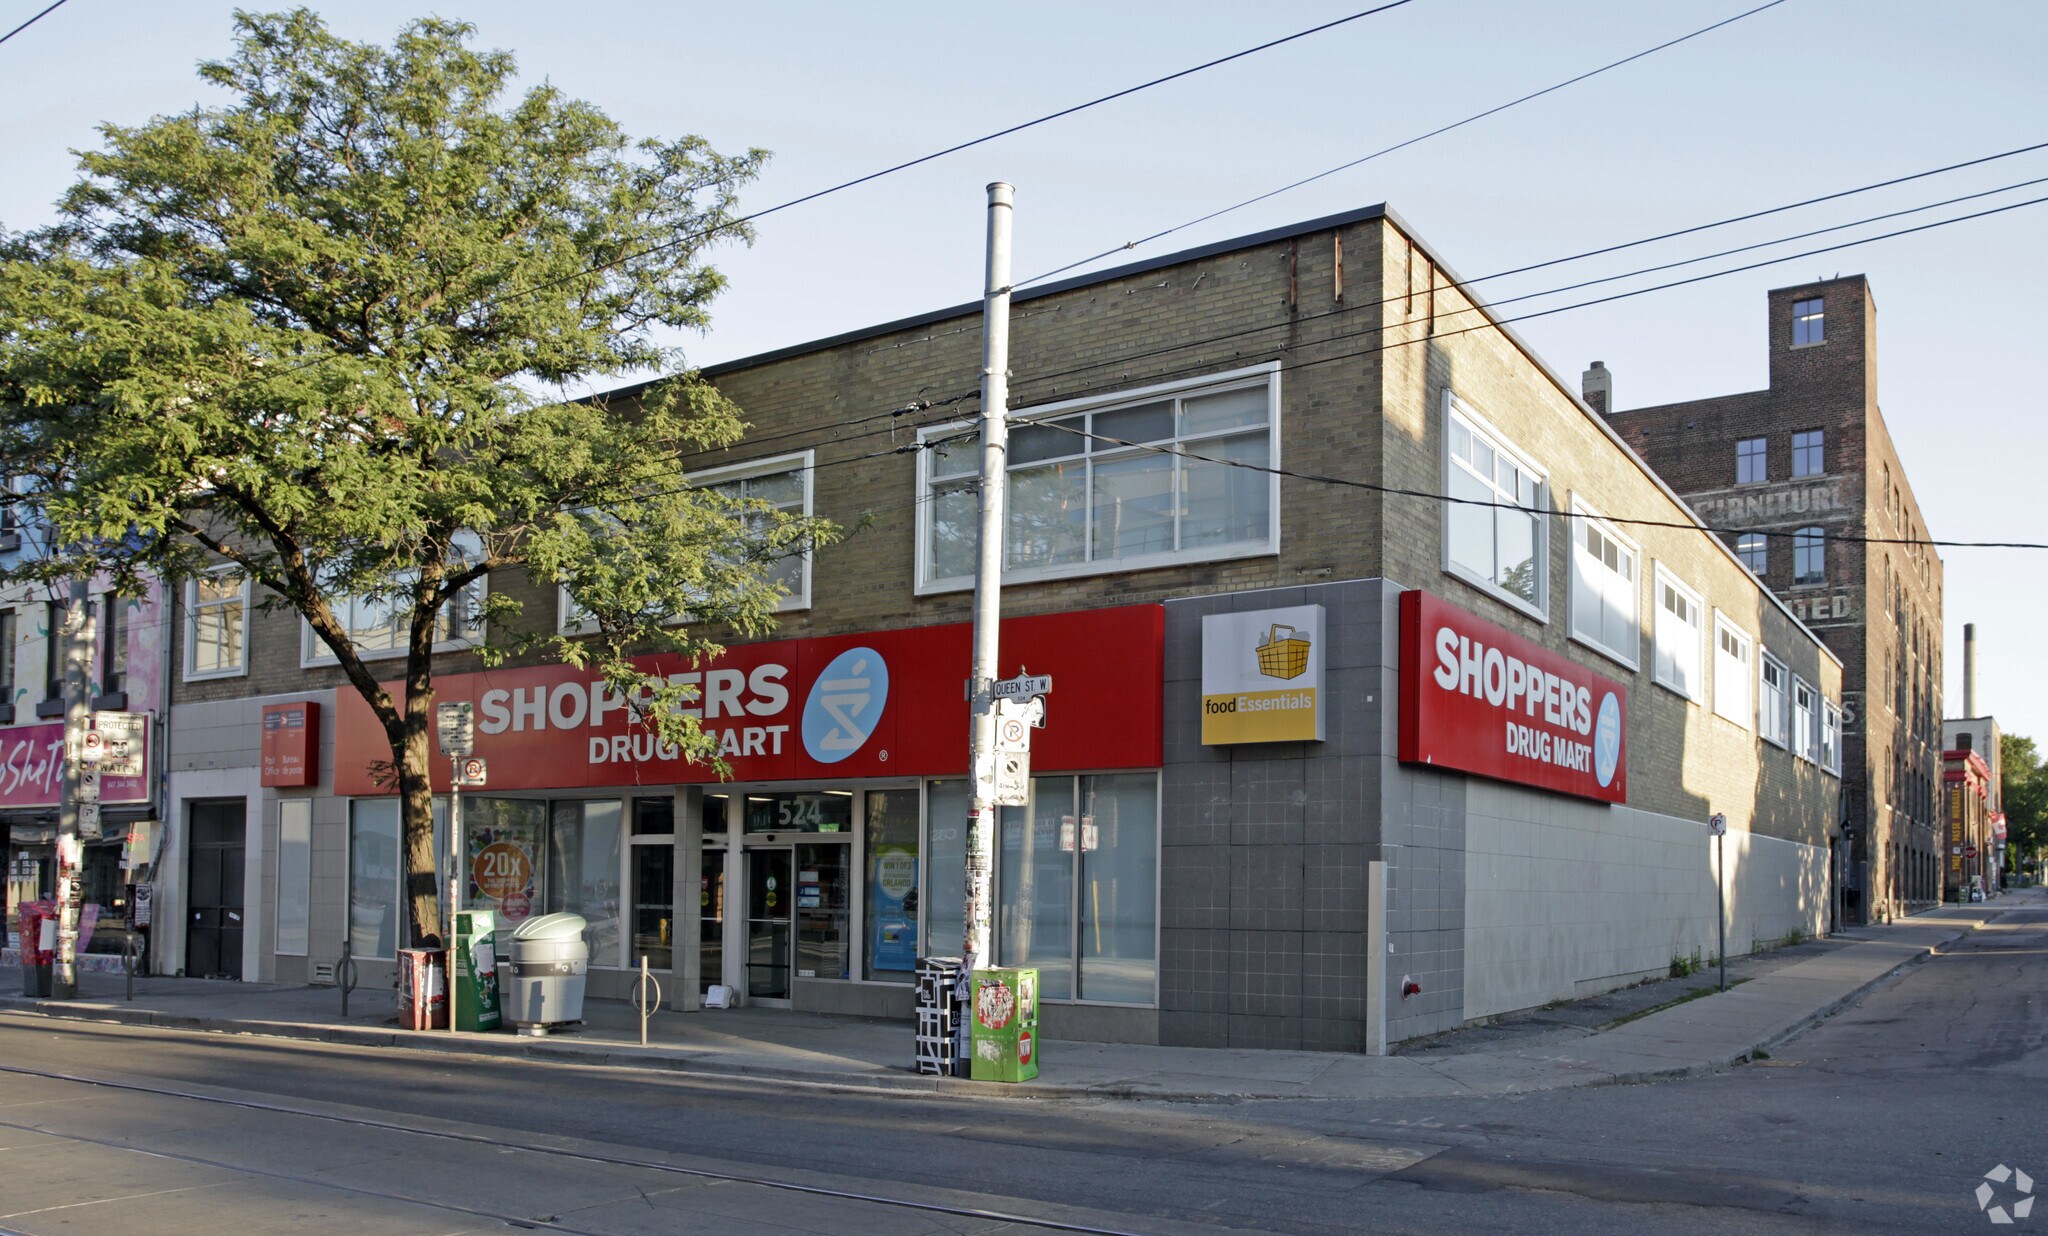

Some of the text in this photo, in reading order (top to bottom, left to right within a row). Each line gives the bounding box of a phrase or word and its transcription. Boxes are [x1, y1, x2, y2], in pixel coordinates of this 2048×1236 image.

[996, 682, 1021, 695] QUEEN
[1433, 626, 1592, 736] SHOPPERS
[478, 663, 790, 735] SHOPPERS
[98, 720, 141, 731] PROTECTED
[282, 755, 300, 764] Bureau
[589, 732, 679, 764] DRUG
[1506, 721, 1592, 773] DRUG MART
[778, 800, 821, 826] 524
[483, 852, 521, 877] 20x
[882, 861, 895, 870] WIN
[882, 879, 911, 887] ORLANDO
